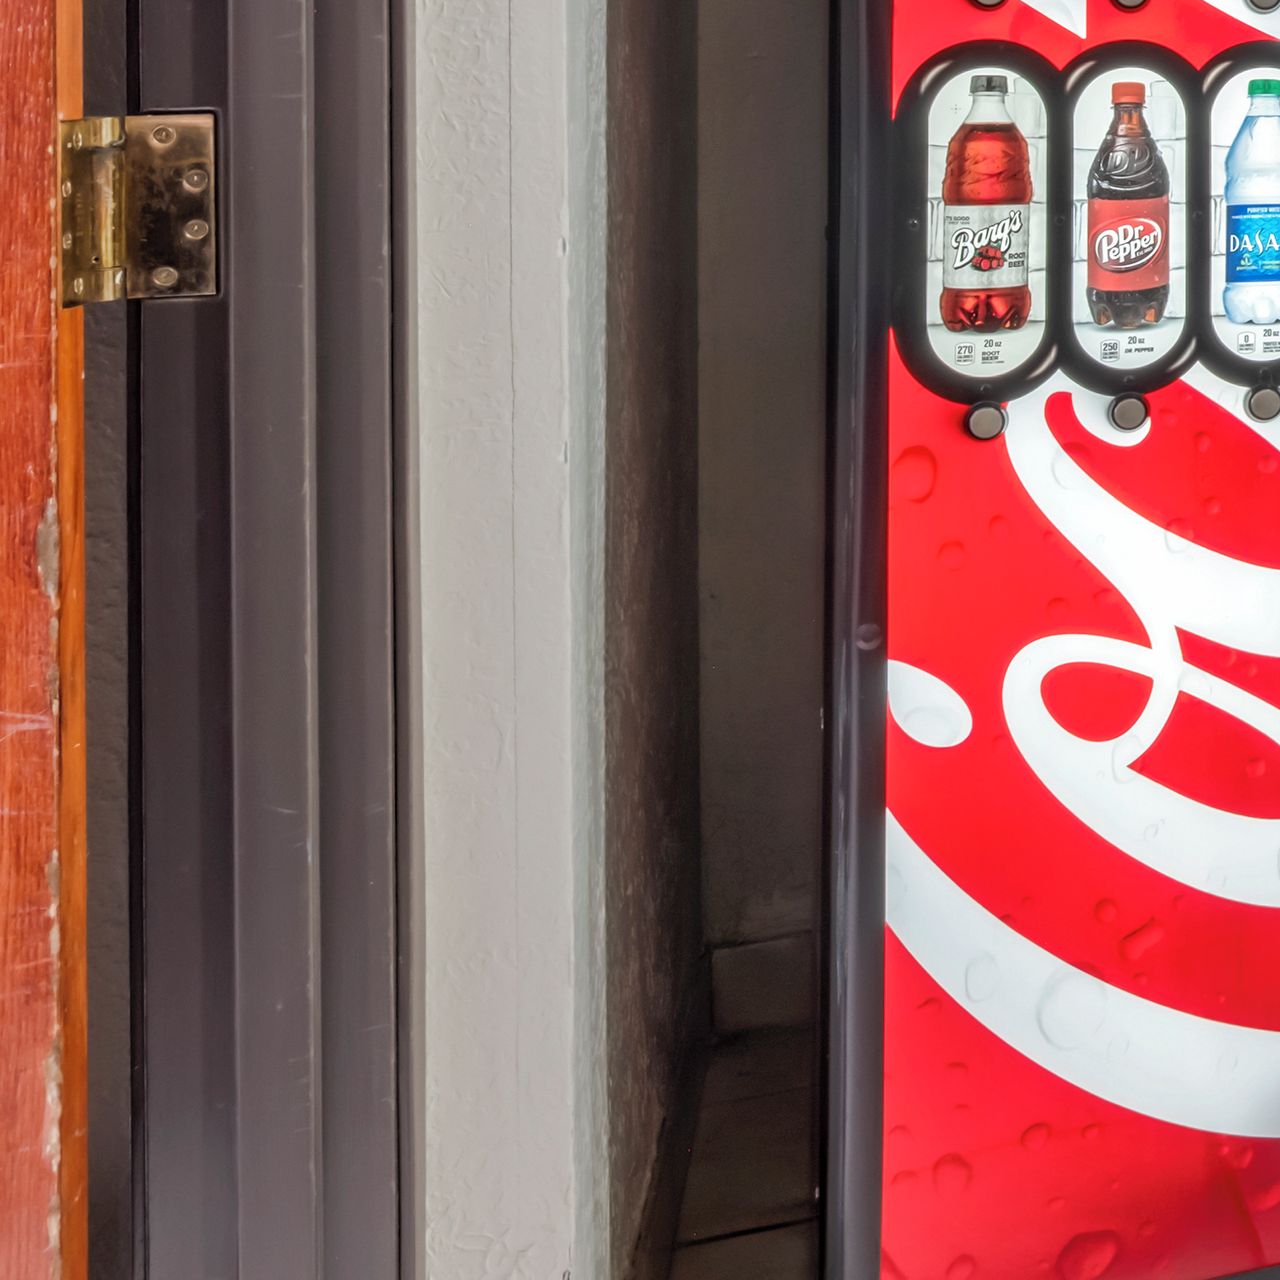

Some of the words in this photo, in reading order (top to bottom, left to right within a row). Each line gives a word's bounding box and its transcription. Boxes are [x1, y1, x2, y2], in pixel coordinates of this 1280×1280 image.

[1117, 224, 1144, 245] Dr
[951, 210, 1023, 270] Barq's
[1098, 229, 1158, 263] Pepper
[1263, 329, 1272, 337] 20
[984, 339, 993, 347] 20
[1127, 336, 1137, 344] 20
[1243, 335, 1249, 343] 0
[957, 345, 973, 355] 270
[1103, 342, 1118, 352] 250
